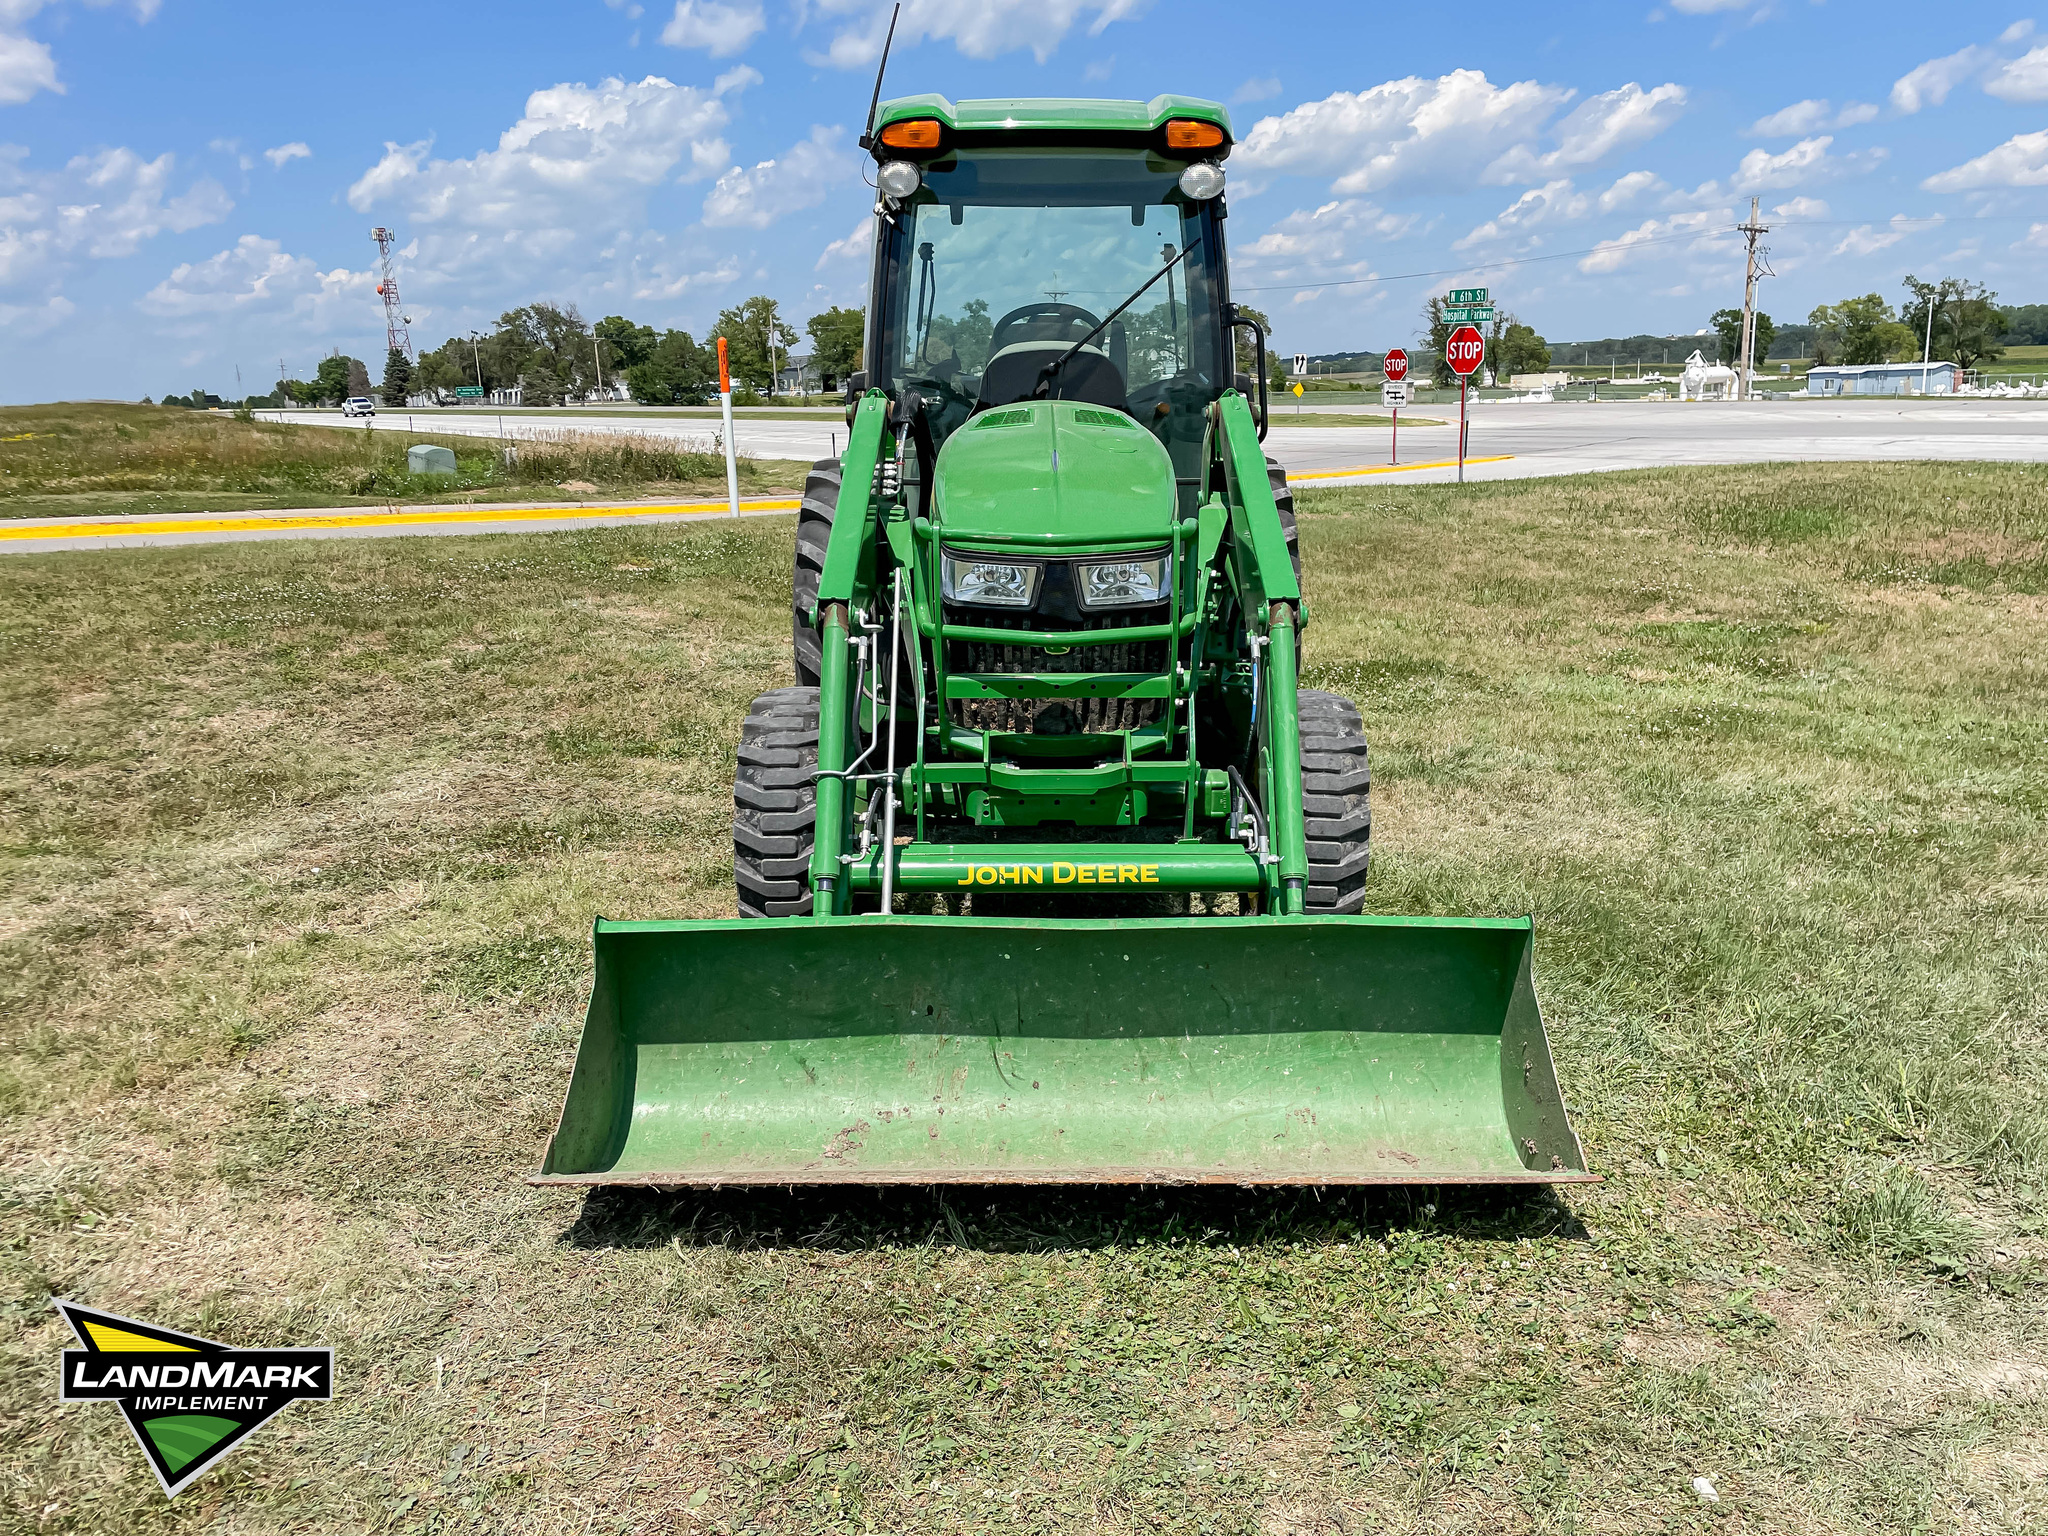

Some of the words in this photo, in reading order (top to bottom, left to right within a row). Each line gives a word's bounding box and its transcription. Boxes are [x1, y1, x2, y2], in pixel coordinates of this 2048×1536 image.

[1450, 291, 1456, 302] N
[1460, 291, 1473, 302] 6th
[1476, 290, 1484, 301] St
[1443, 309, 1468, 322] Hospital
[1470, 309, 1493, 321] Parkway
[1449, 341, 1482, 360] STOP
[1385, 358, 1406, 371] STOP
[957, 862, 1043, 886] JOHN
[1052, 861, 1160, 884] DEERE
